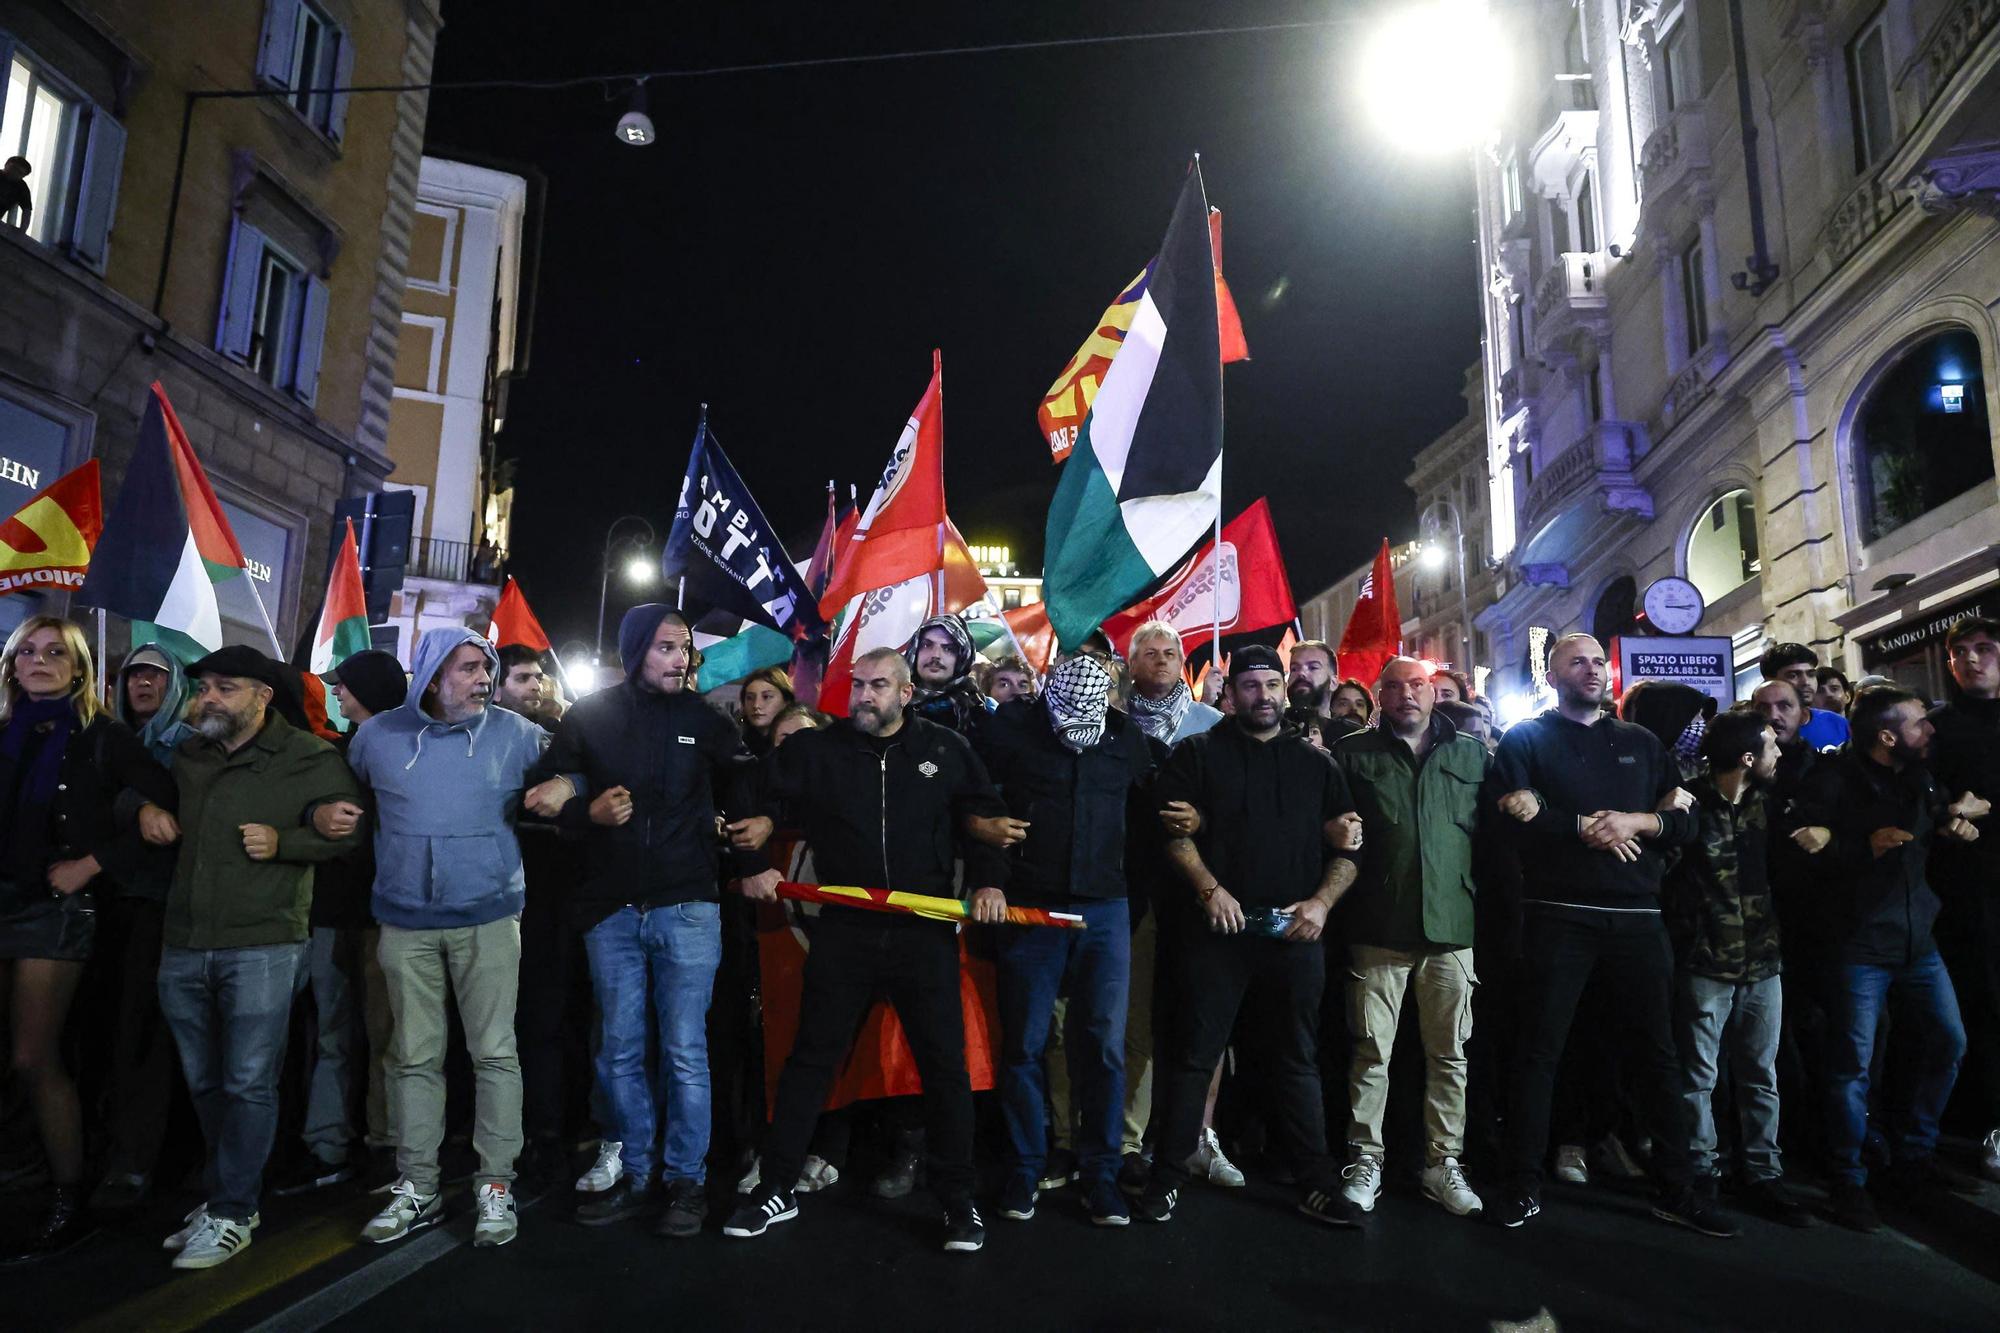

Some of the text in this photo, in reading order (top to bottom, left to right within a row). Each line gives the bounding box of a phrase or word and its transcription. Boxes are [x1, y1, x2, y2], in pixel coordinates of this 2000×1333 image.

[1881, 629, 1926, 653] SANDRO
[1638, 655, 1718, 665] SPAZIO LIBERO
